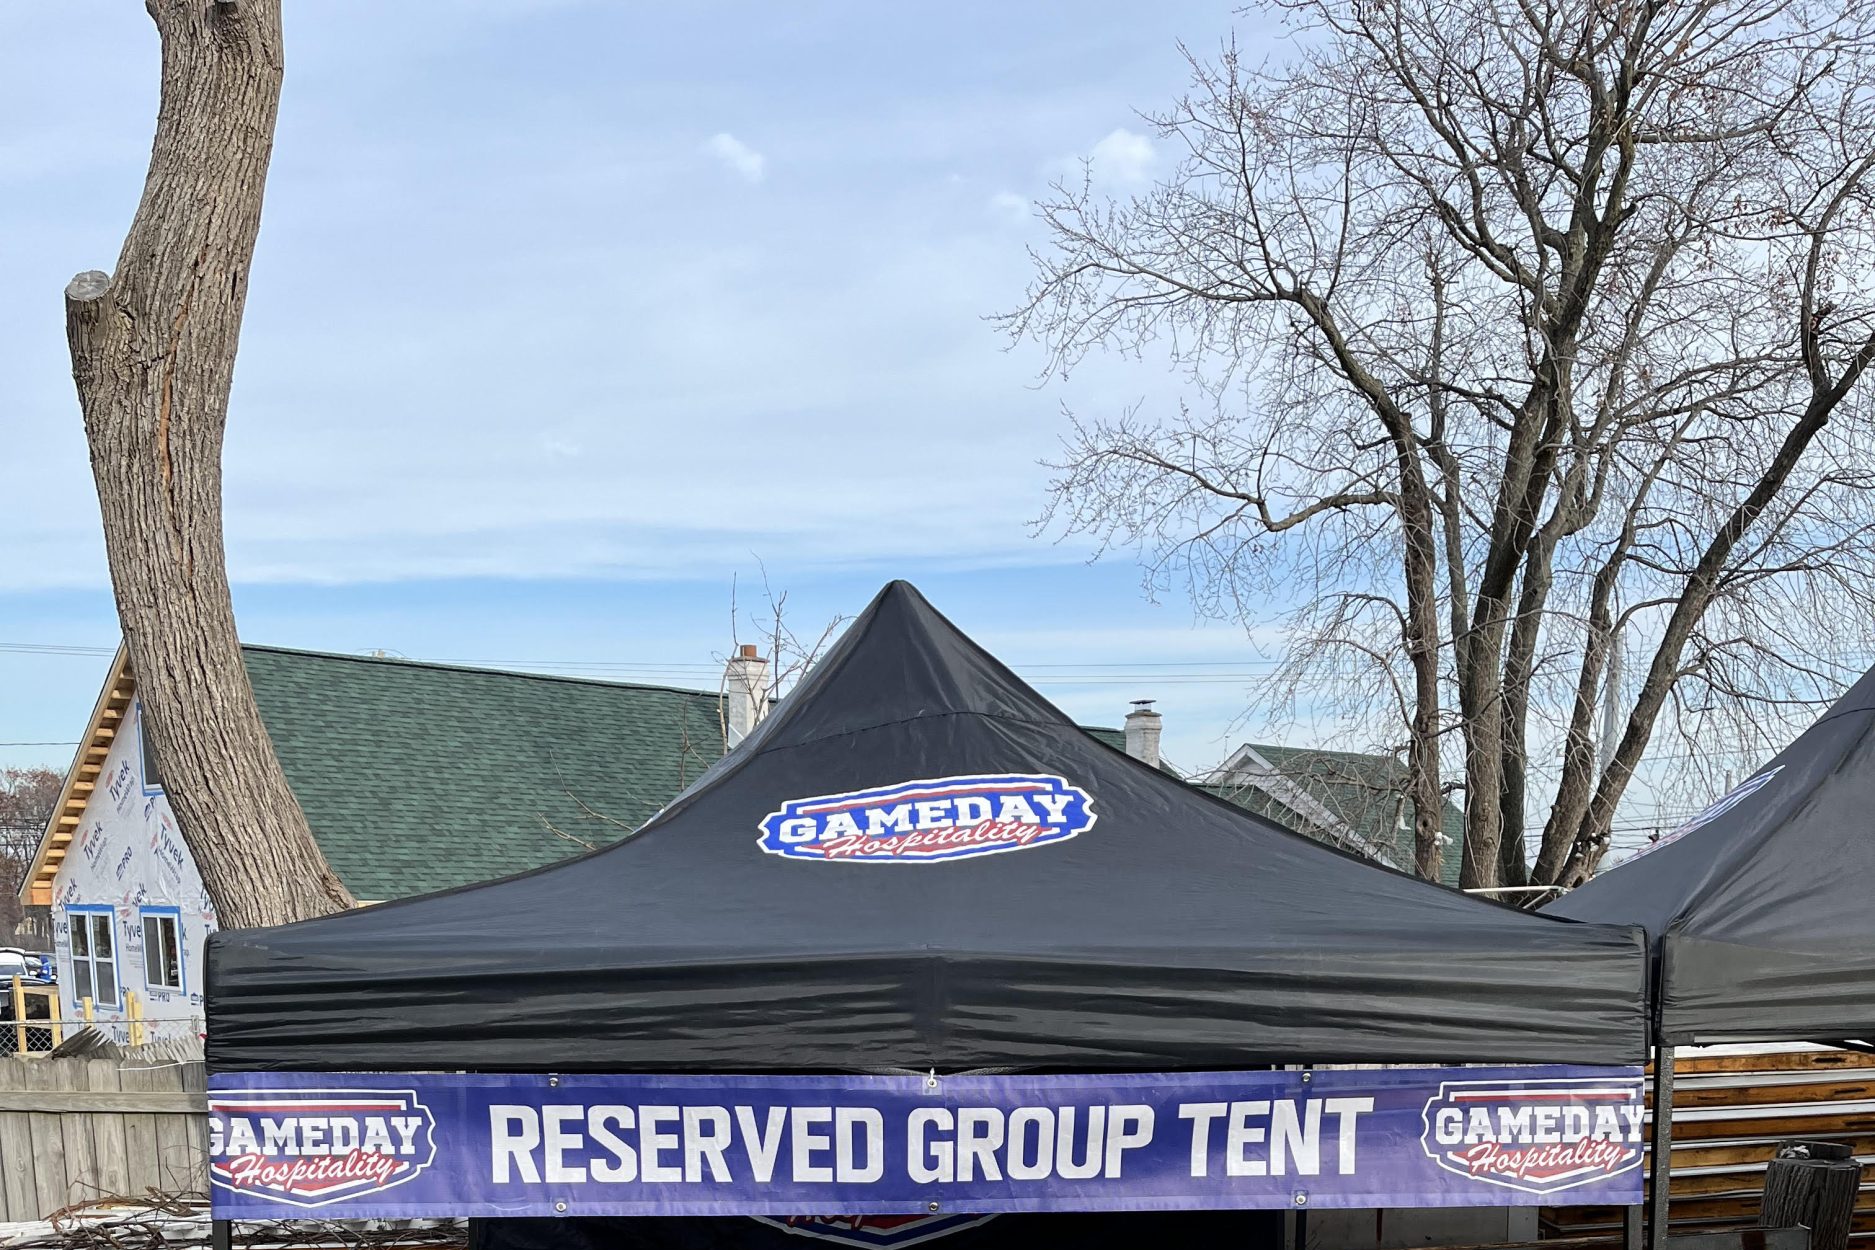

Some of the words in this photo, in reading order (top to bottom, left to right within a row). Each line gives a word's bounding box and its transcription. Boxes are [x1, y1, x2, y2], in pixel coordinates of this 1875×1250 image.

[109, 760, 130, 802] Tyvek
[779, 794, 1074, 843] GAMEDAY
[83, 820, 103, 861] Tyvek
[160, 822, 184, 872] Tyvek
[826, 820, 1039, 858] Hospitality
[122, 920, 142, 942] Tyve
[112, 1025, 130, 1044] Tyve
[208, 1116, 422, 1156] GAMEDAY
[489, 1104, 884, 1184] RESERVED
[907, 1104, 1154, 1184] GROUP
[1178, 1096, 1374, 1178] TENT
[1435, 1105, 1645, 1145] GAMEDAY
[229, 1149, 393, 1189] Hospitality
[1467, 1138, 1621, 1175] Hospitality
